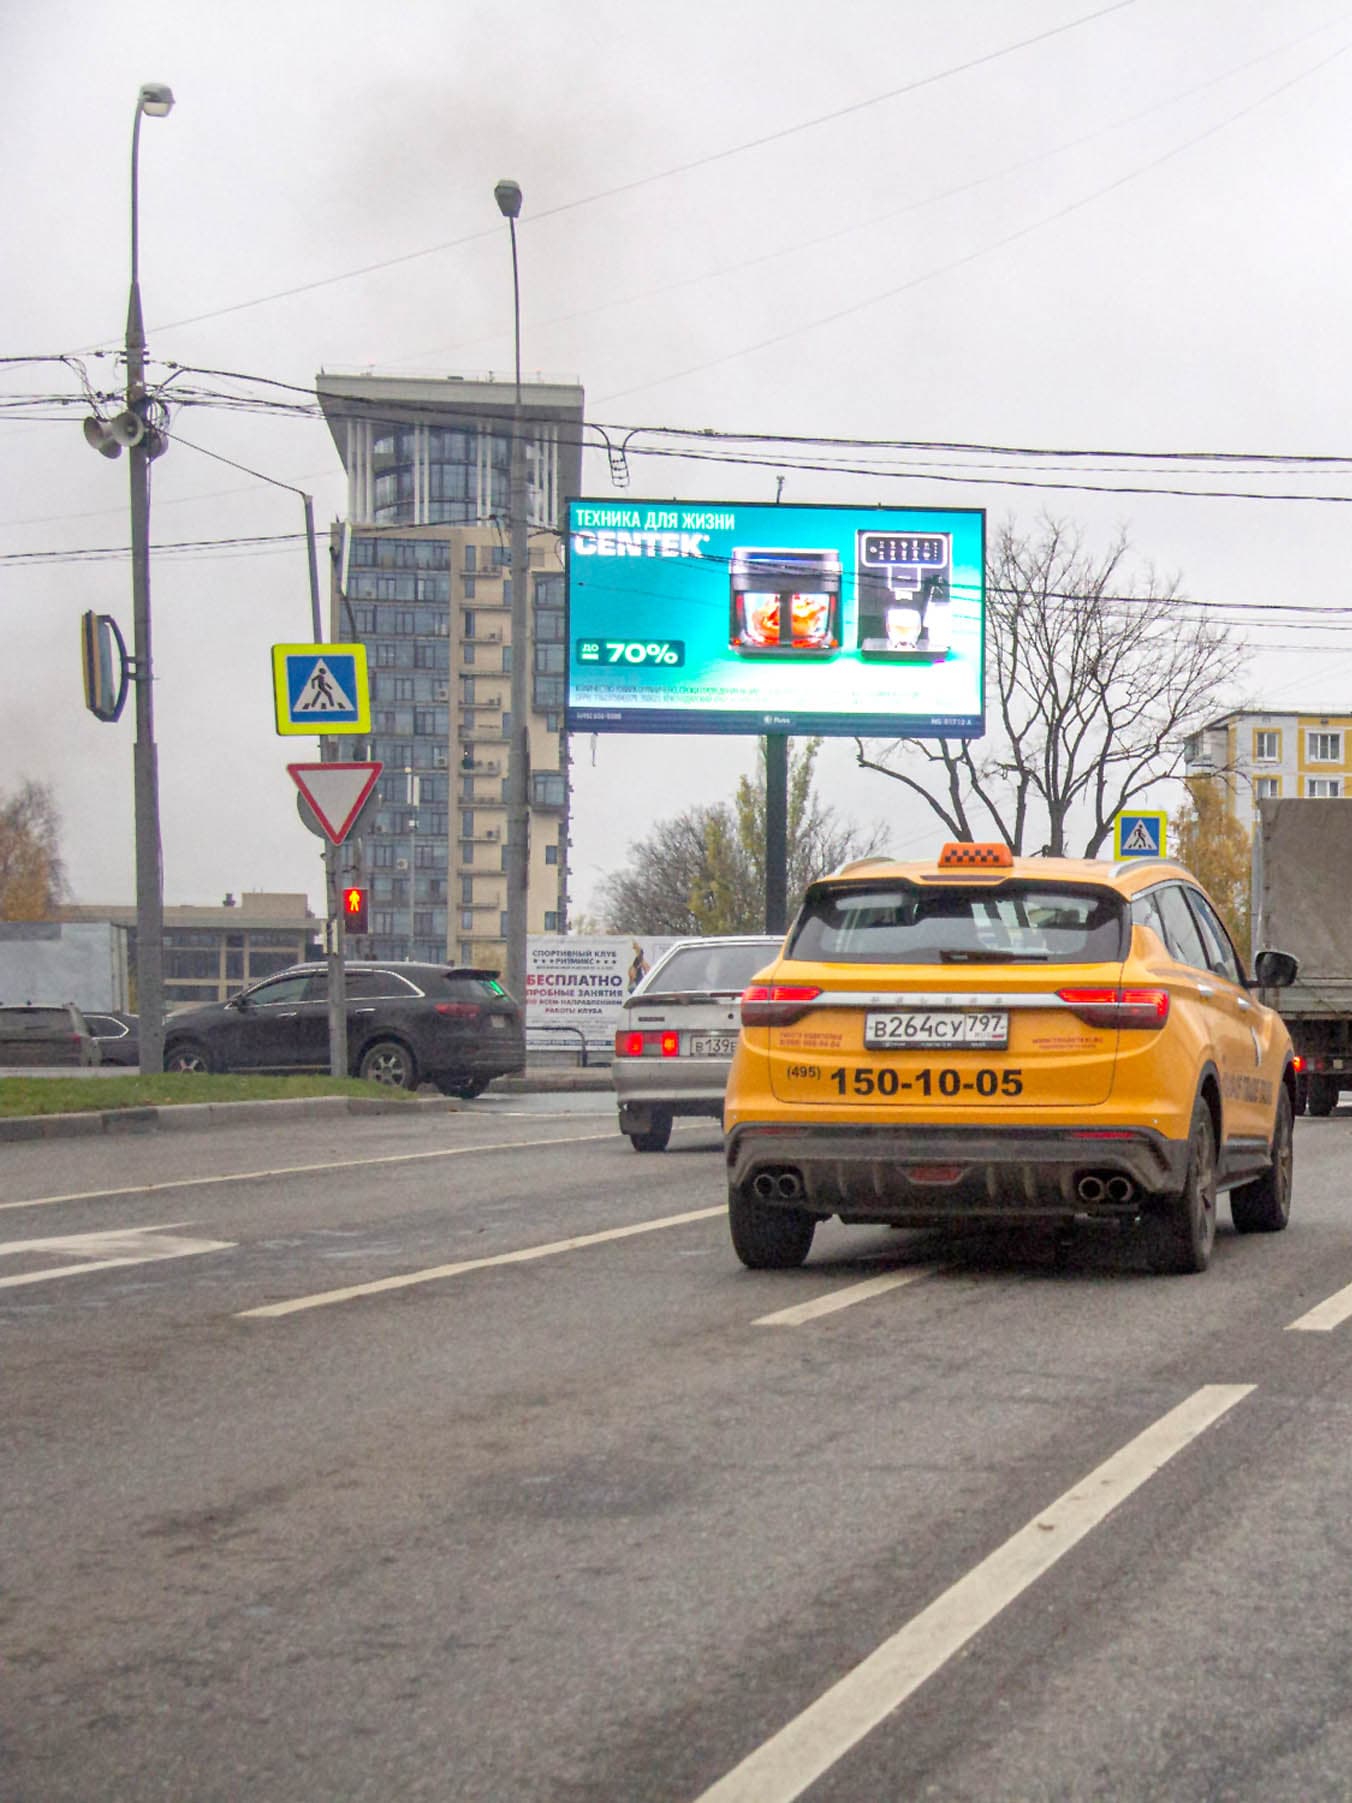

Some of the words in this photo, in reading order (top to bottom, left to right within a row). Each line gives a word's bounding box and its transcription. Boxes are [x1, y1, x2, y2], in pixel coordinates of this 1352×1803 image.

[576, 509, 641, 528] ТЕХНИКА
[644, 512, 679, 530] ДЛЯ
[682, 512, 735, 530] ЖИЗНИ
[574, 530, 704, 557] CENTEK
[606, 643, 679, 665] 70%
[532, 950, 592, 958] СПОРТИВНЫЙ
[594, 950, 617, 958] КЛУБ
[527, 974, 623, 987] БЕСПЛАТНО
[526, 988, 574, 997] ПРОБНЫЕ
[577, 989, 623, 997] ЗАНЯТИЯ
[968, 1015, 1002, 1032] 797
[787, 1066, 821, 1080] (495)
[831, 1068, 1023, 1096] 150-10-05
